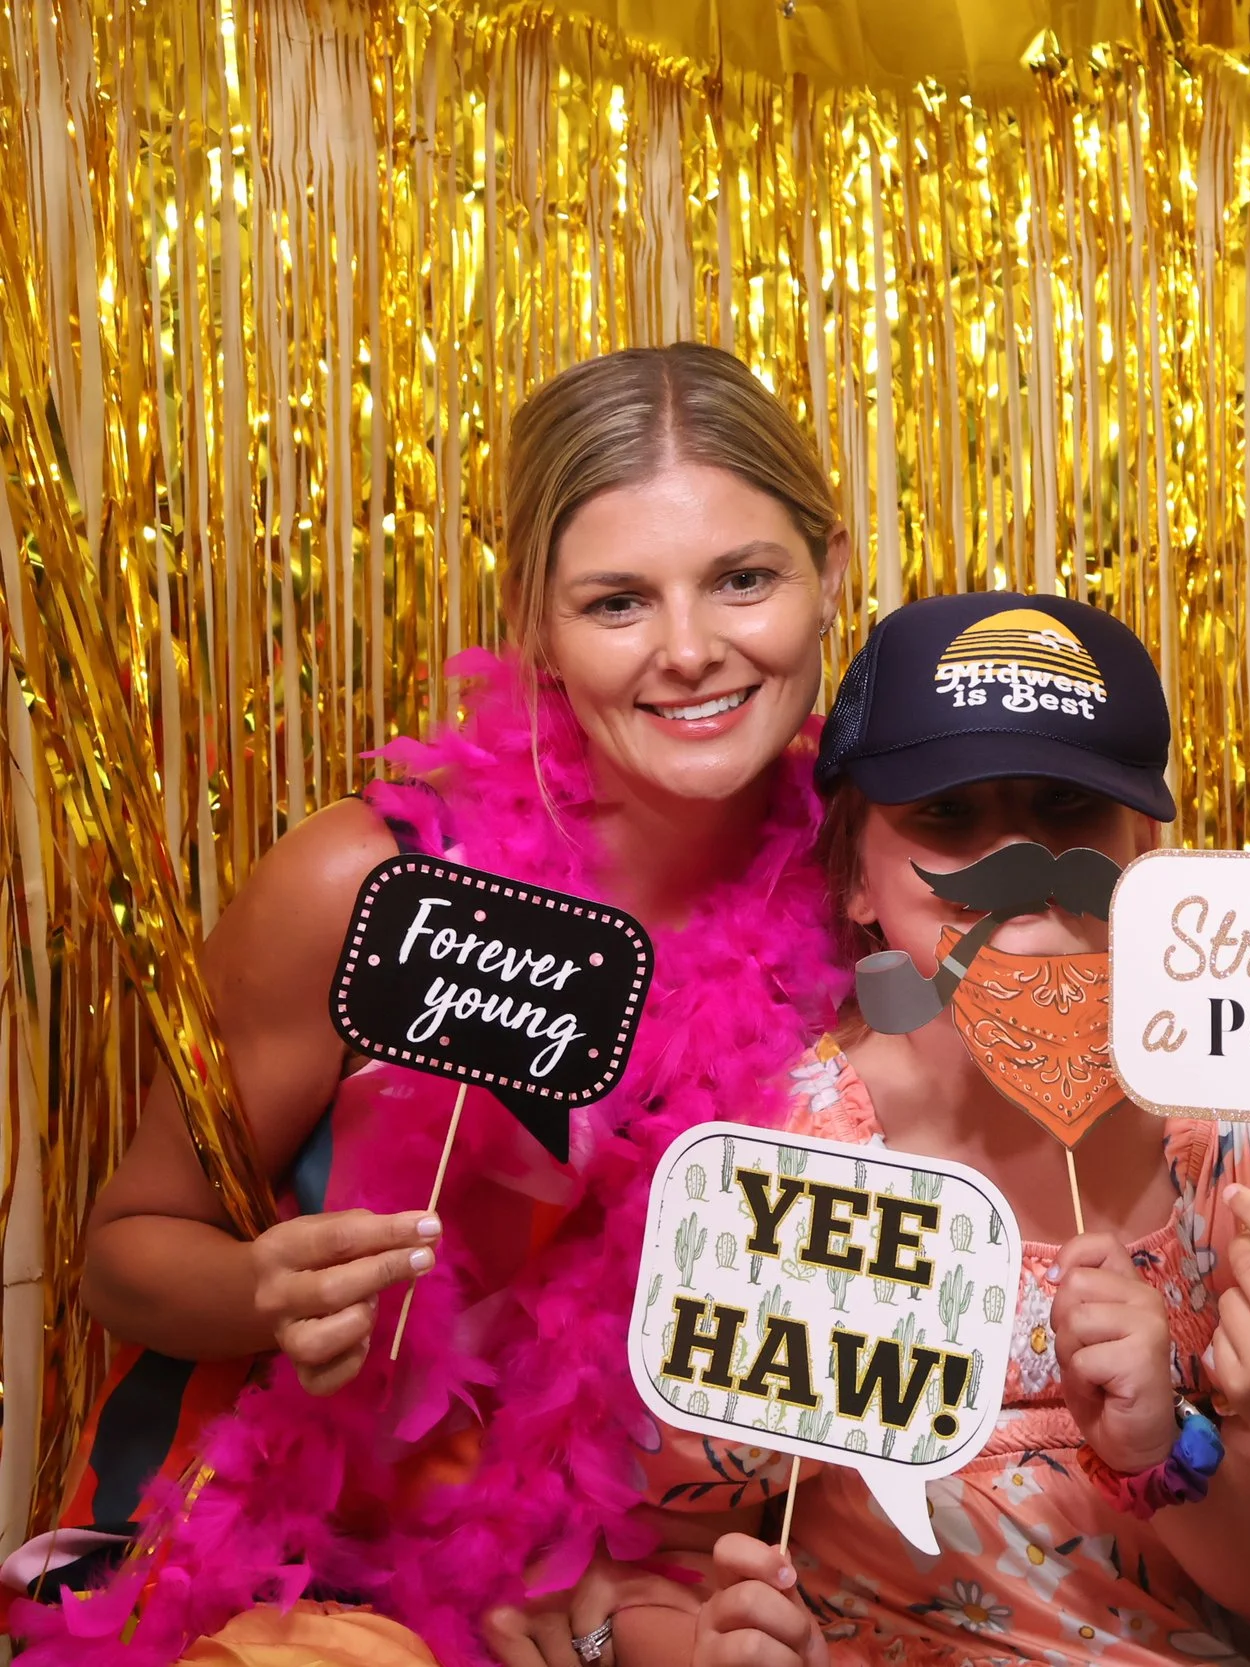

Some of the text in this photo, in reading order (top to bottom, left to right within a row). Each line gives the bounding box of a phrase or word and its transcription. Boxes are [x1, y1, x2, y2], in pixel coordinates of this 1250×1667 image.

[936, 662, 1107, 702] Midwest
[953, 683, 1095, 720] is Best
[399, 897, 582, 991] Forever
[406, 976, 587, 1078] young
[1141, 1009, 1188, 1053] a
[735, 1166, 942, 1289] YEE
[660, 1295, 973, 1440] HAW!
